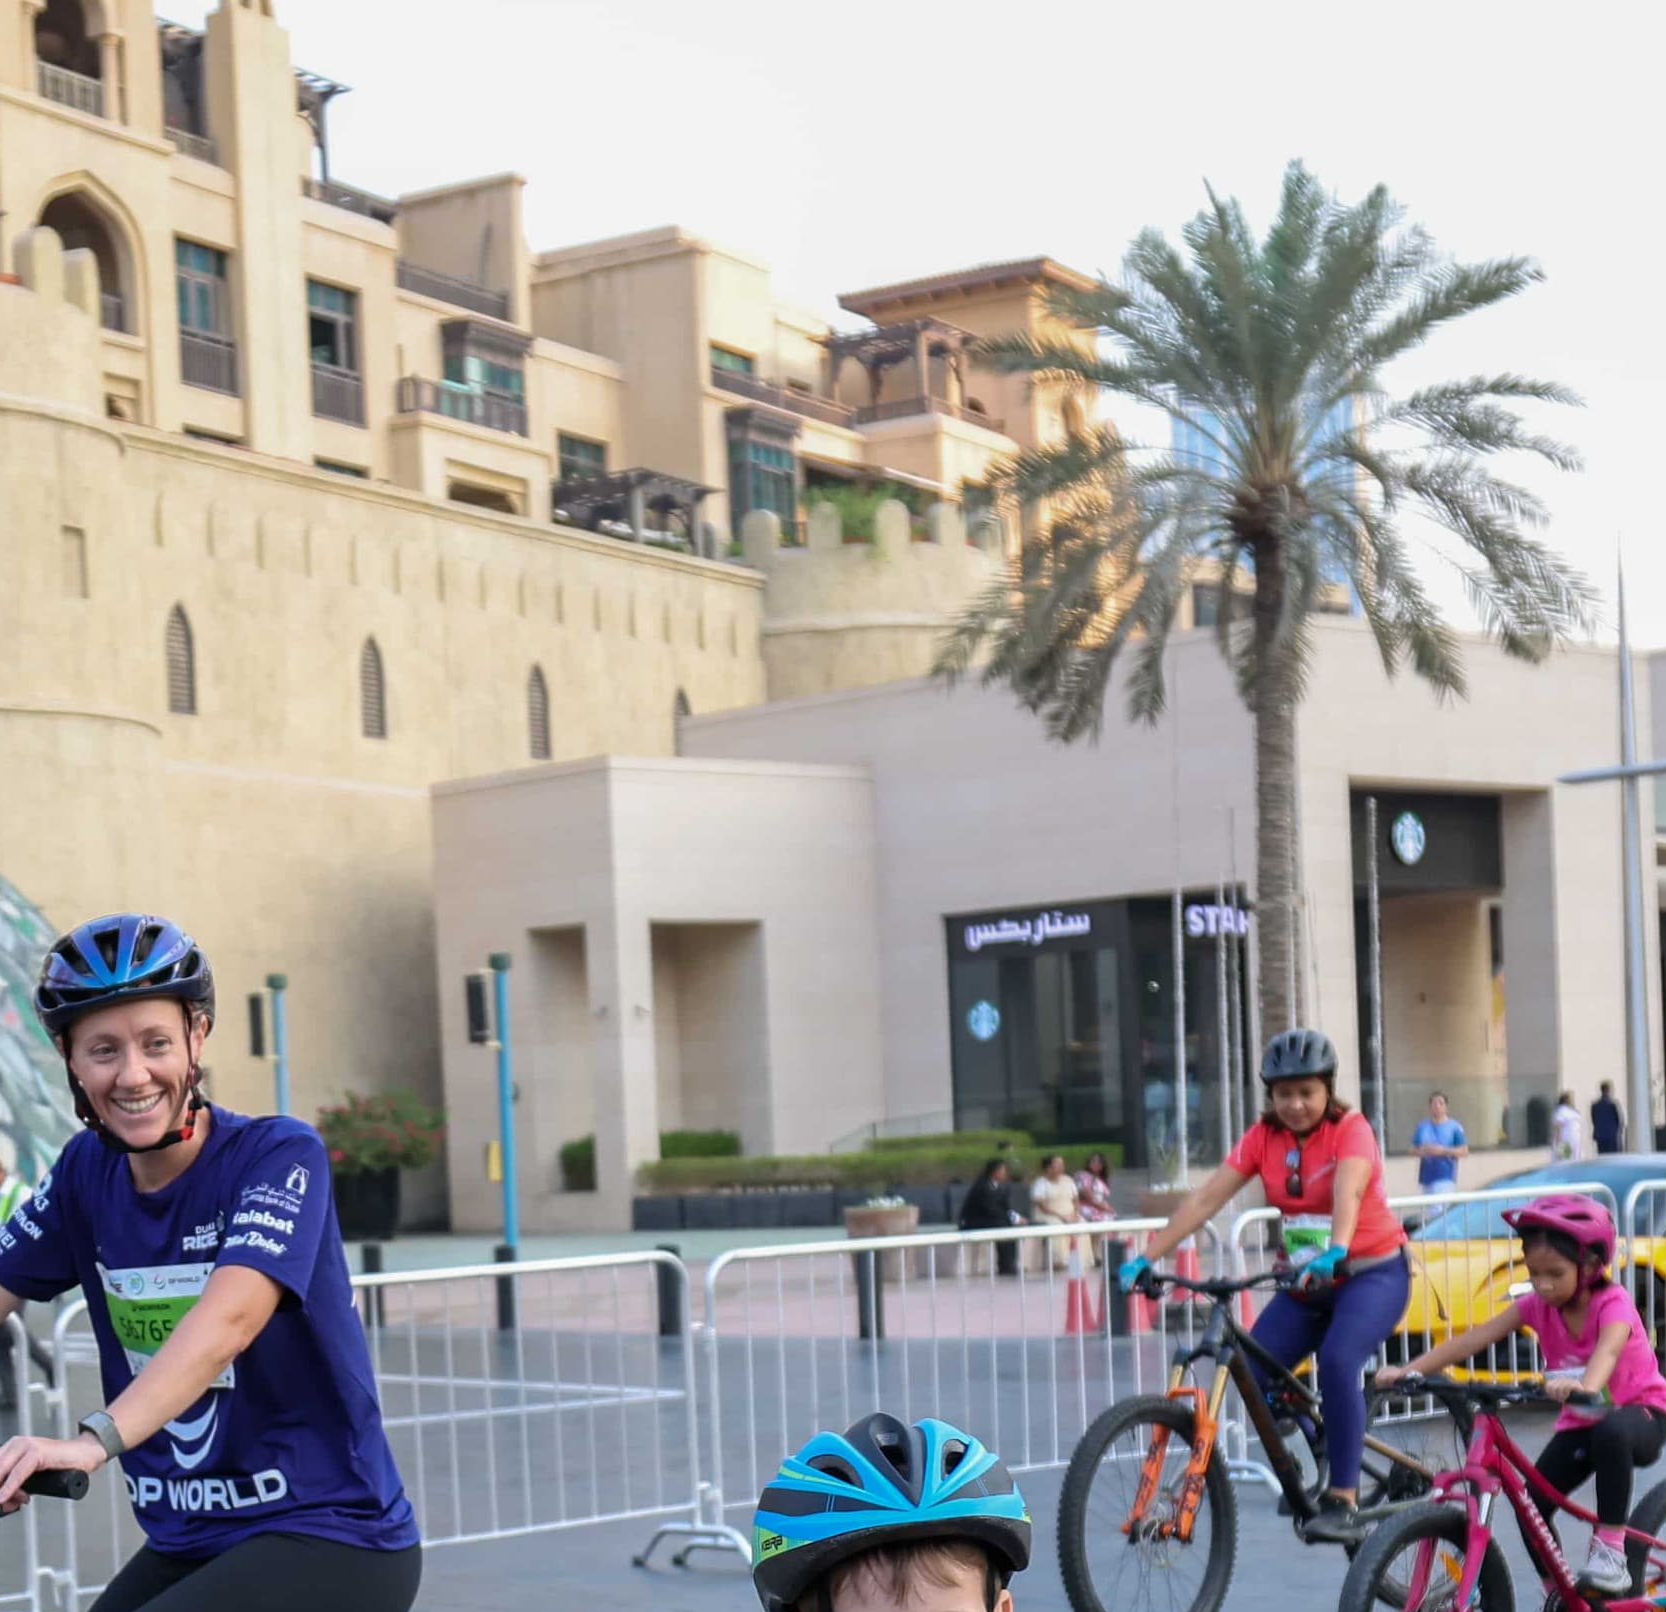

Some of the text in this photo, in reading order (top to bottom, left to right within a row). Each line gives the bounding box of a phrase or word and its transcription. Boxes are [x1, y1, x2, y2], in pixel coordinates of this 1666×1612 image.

[964, 909, 1091, 950] ستاربكس
[233, 1209, 295, 1235] talabat
[167, 1468, 287, 1511] WORLD
